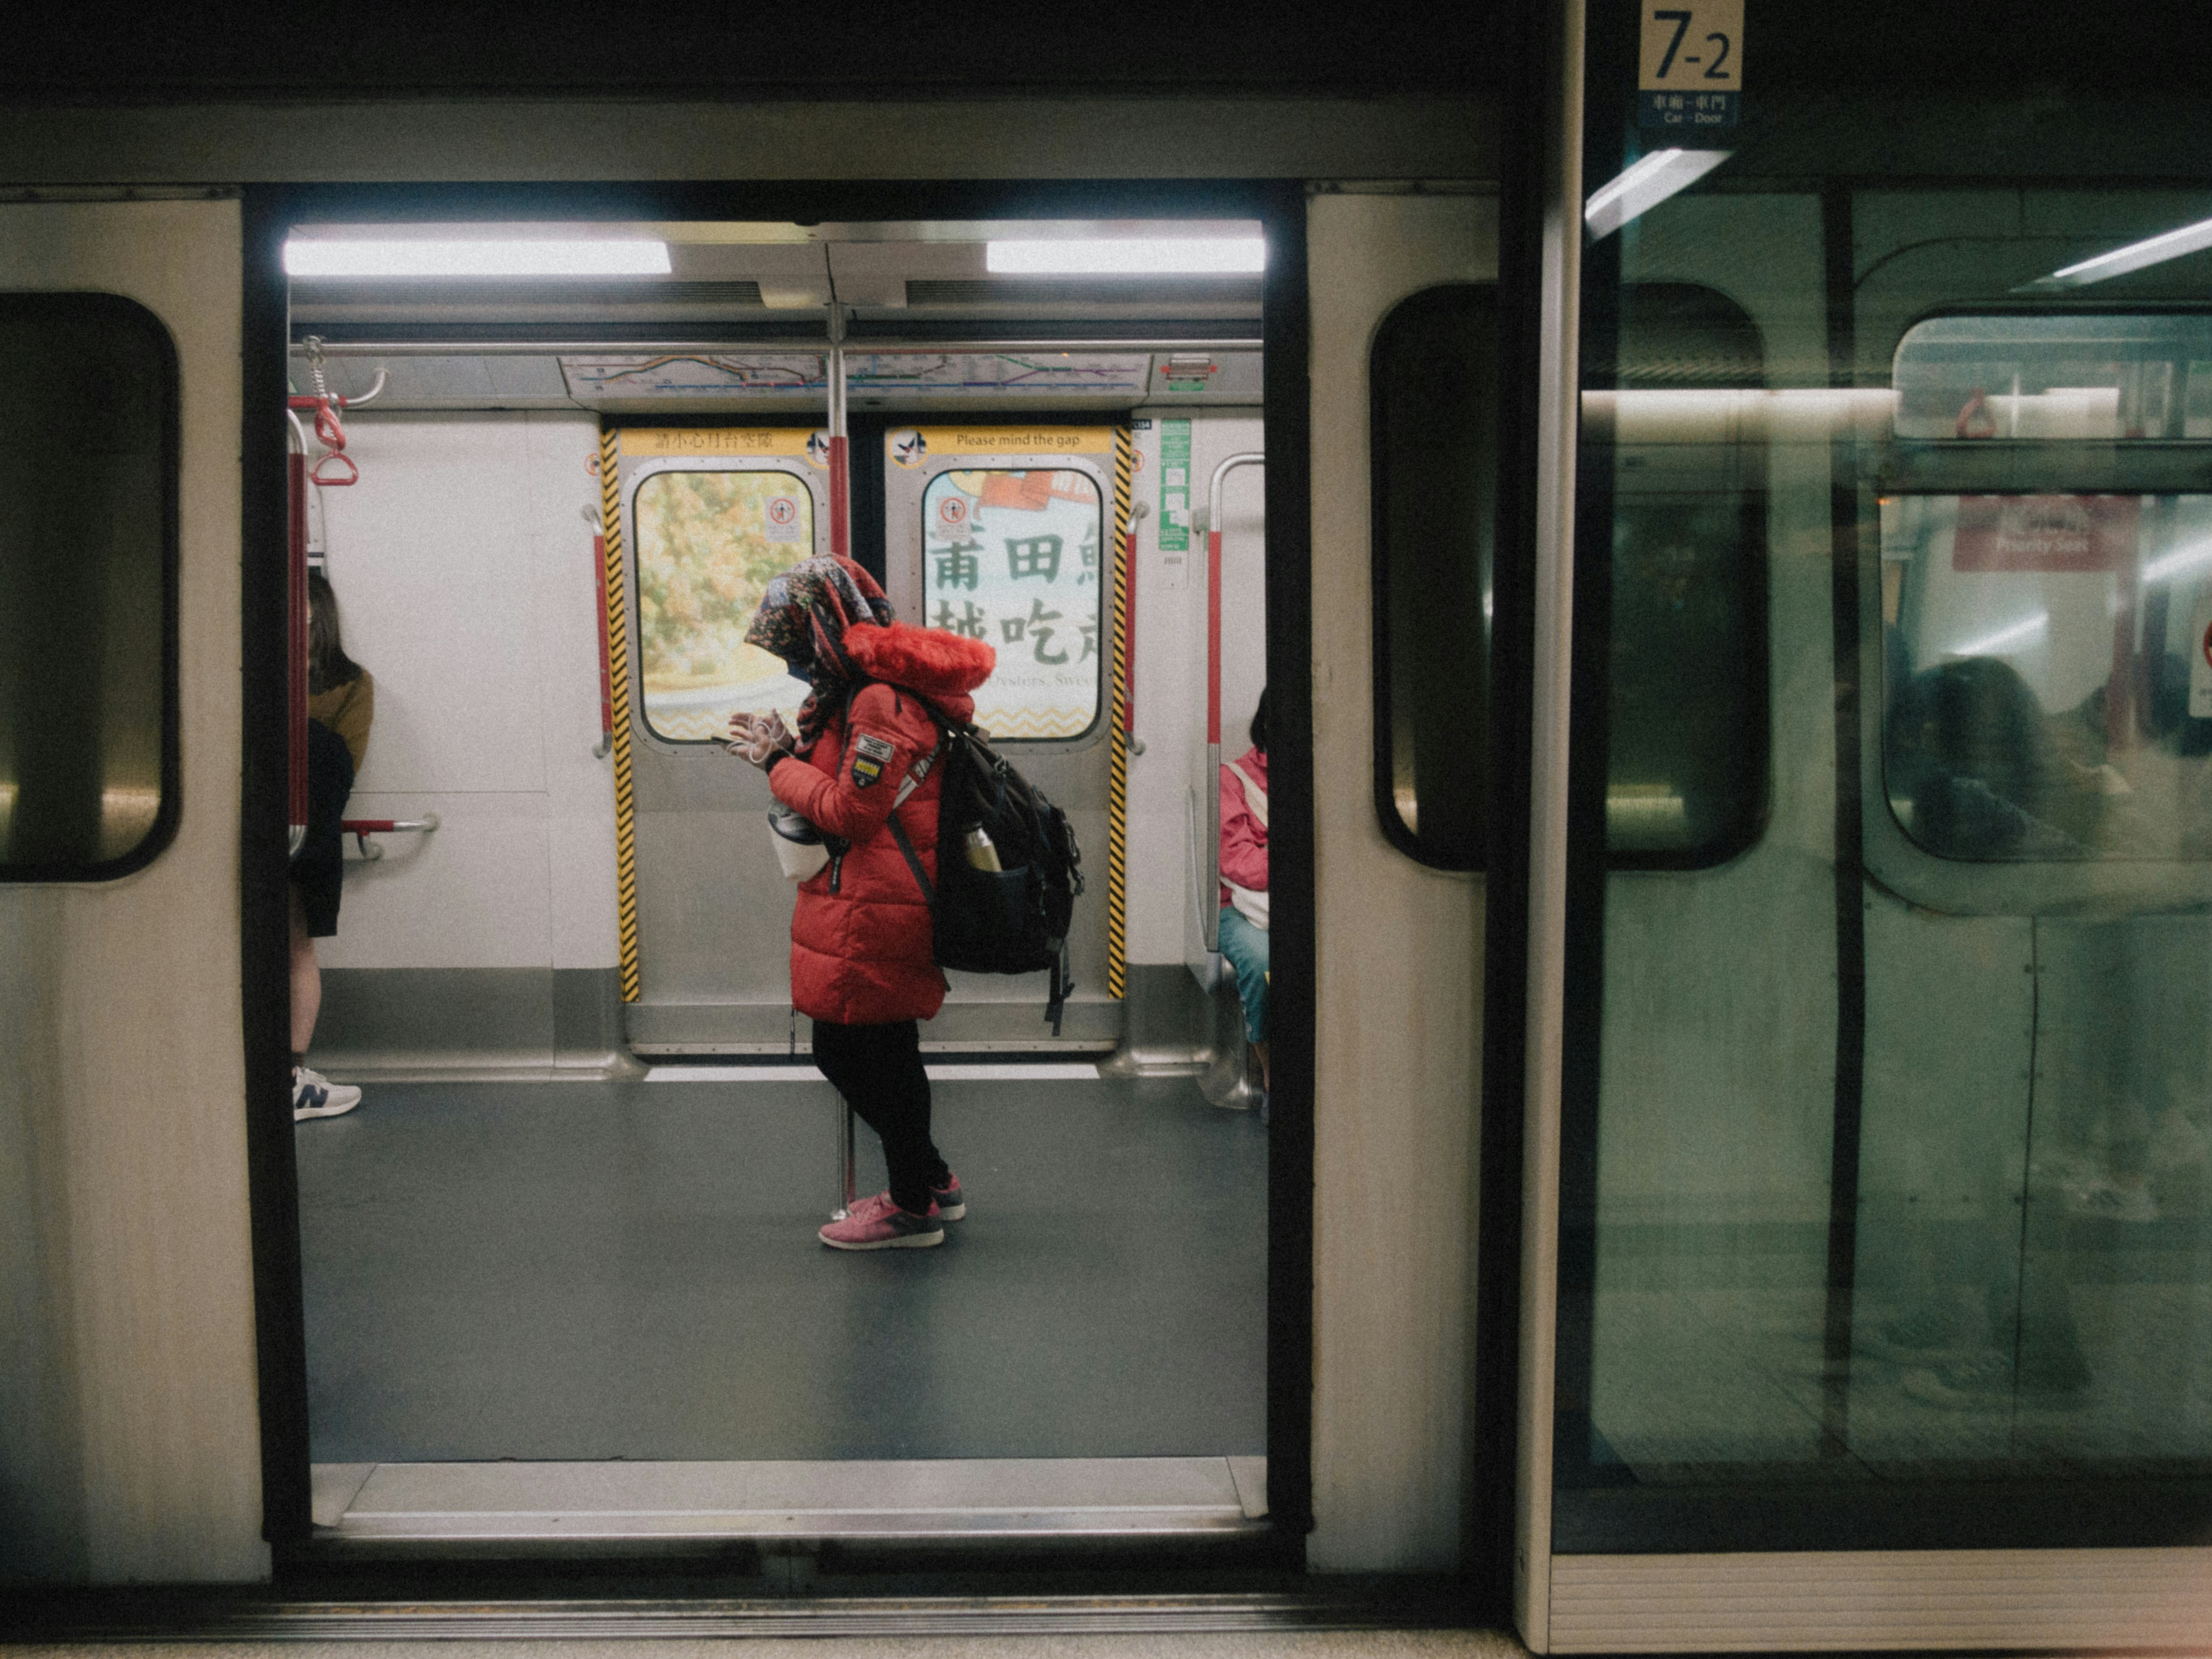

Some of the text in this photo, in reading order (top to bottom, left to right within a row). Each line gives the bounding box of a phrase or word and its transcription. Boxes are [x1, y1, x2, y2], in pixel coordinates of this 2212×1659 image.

[1654, 10, 1730, 80] 7-2
[1664, 112, 1682, 123] Car
[1694, 112, 1722, 123] Door
[956, 433, 1081, 448] Please mind the gap
